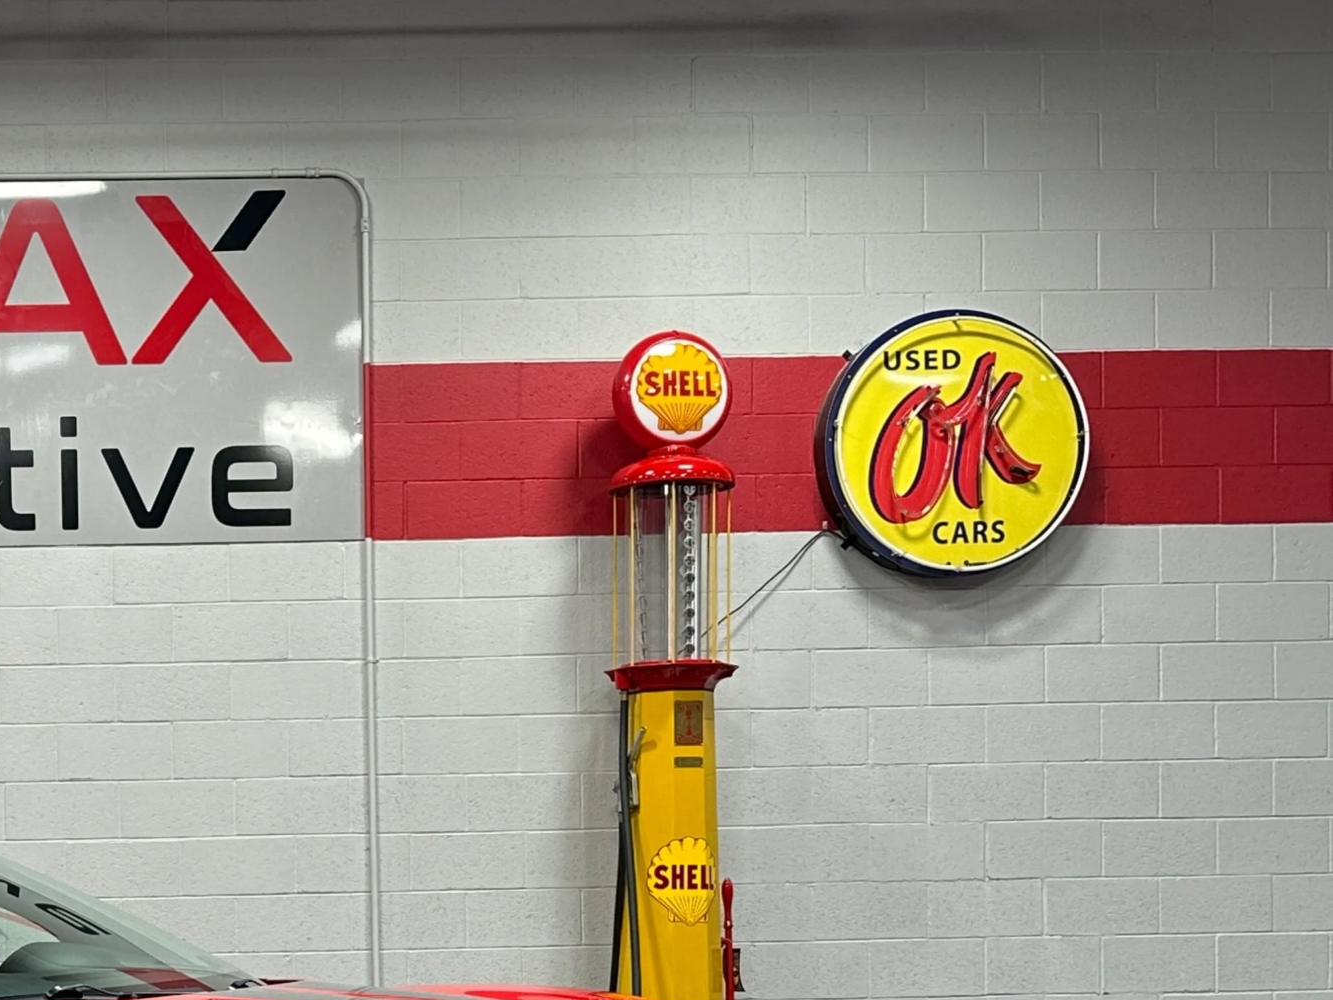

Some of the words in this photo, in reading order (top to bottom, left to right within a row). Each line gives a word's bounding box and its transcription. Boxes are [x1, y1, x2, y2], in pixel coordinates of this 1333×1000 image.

[882, 349, 962, 371] USED
[643, 369, 717, 397] SHELL
[868, 350, 1042, 524] OK
[932, 520, 1006, 544] CARS
[653, 864, 716, 891] SHELL
